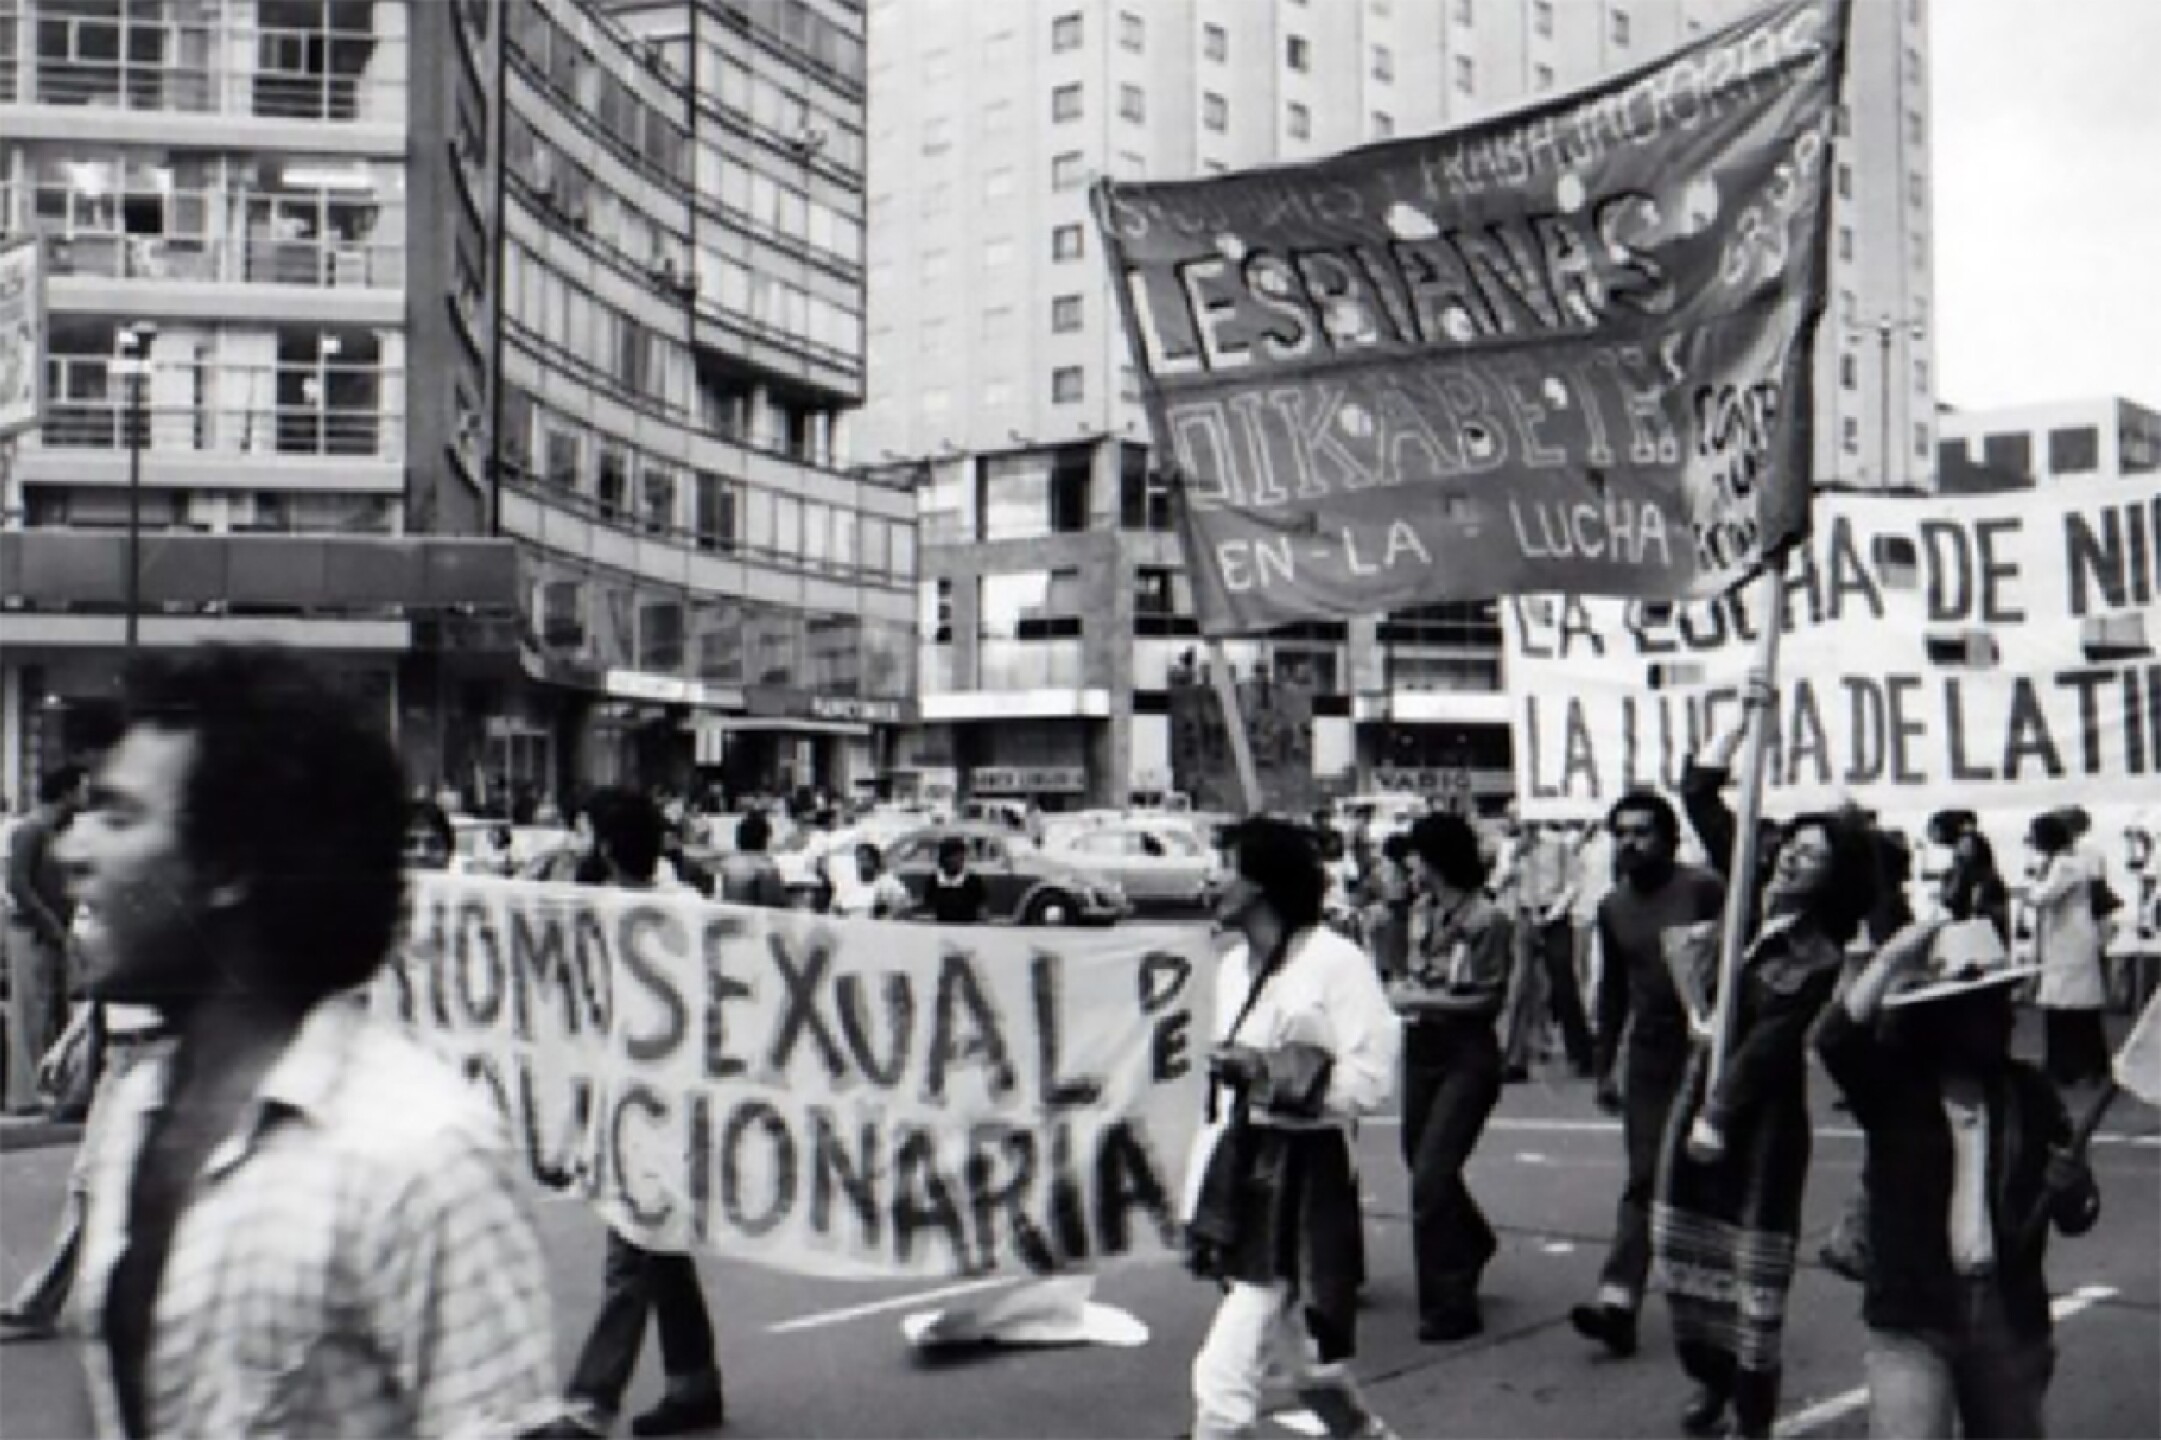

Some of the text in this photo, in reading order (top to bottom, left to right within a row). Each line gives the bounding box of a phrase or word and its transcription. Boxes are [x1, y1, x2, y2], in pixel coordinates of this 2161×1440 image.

[1128, 188, 1678, 378] LESBIANAS
[1510, 498, 1671, 566] LUCHA
[1917, 517, 2026, 624] DE
[1523, 694, 1602, 798] LA
[1841, 673, 1928, 785] DE
[390, 896, 1102, 1108] HOMOSEXUAL
